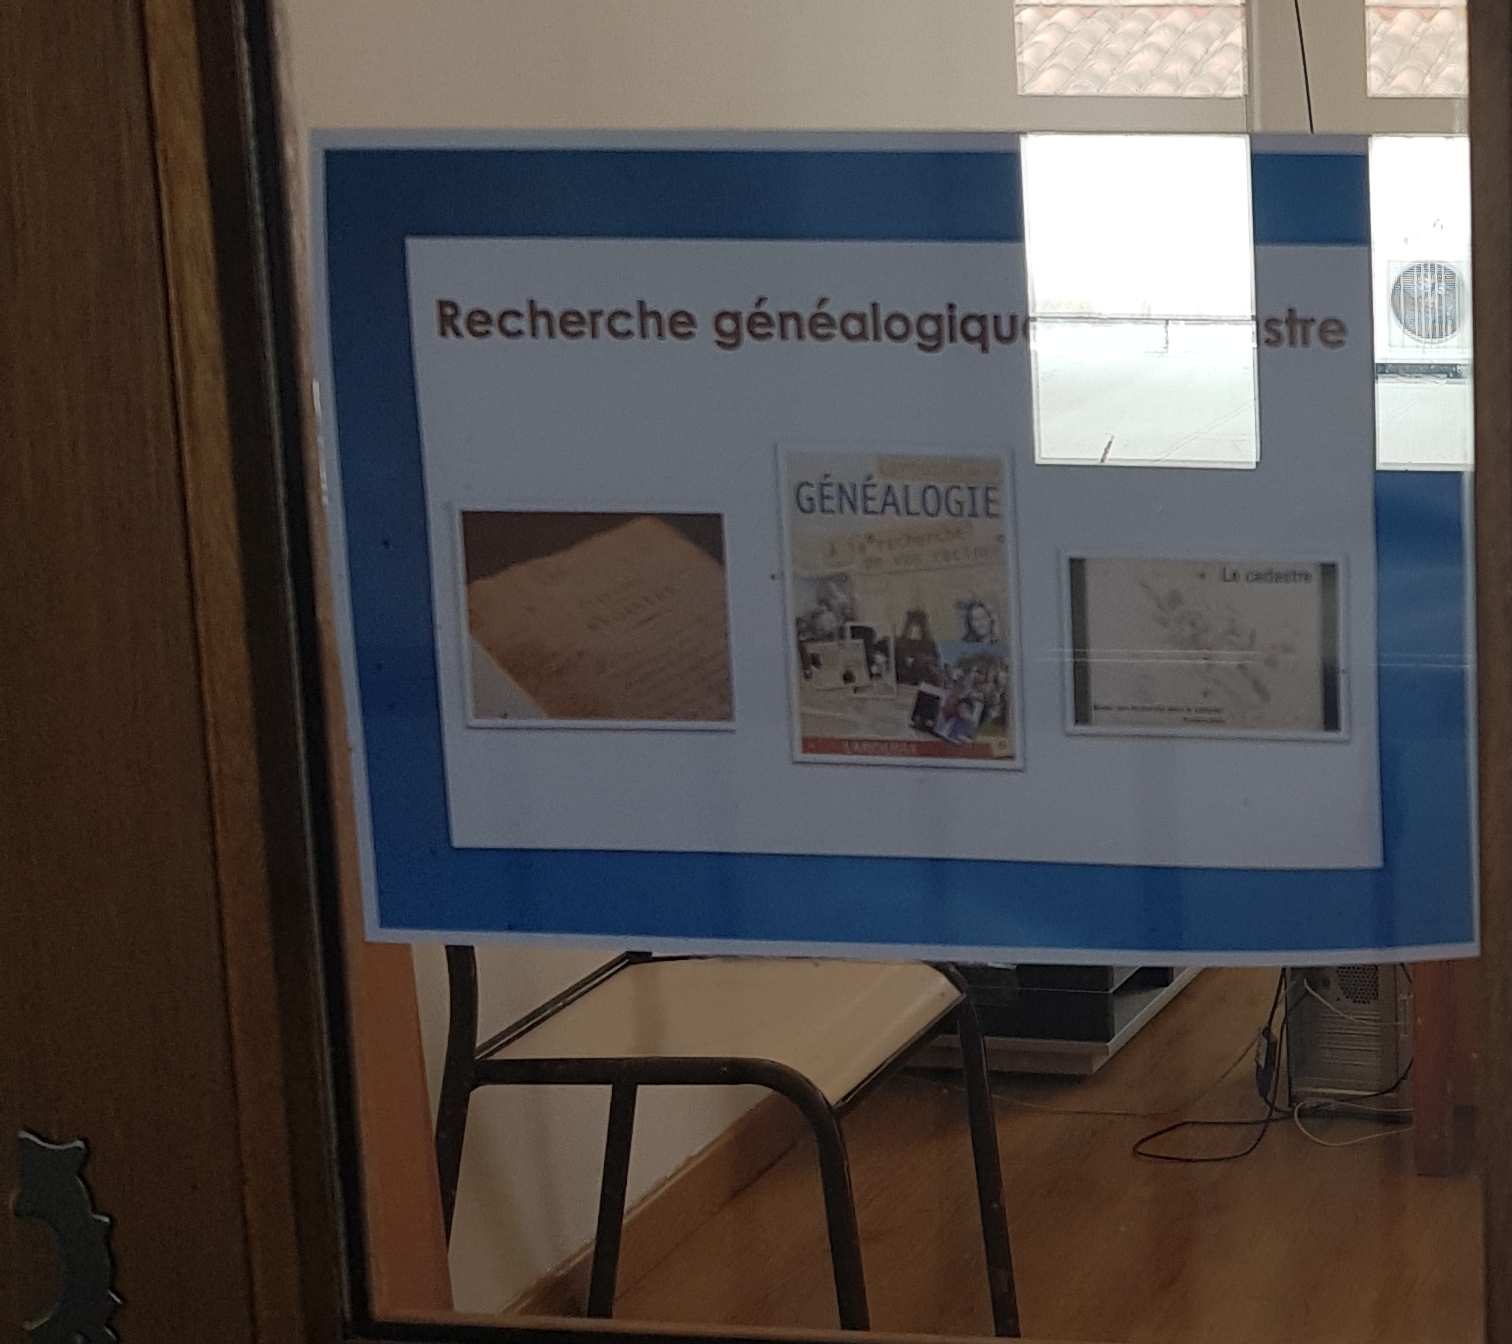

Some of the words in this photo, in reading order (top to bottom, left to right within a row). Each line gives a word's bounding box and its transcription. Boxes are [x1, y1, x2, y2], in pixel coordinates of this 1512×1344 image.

[436, 297, 698, 340] Recherche
[713, 296, 1029, 354] généalogiqu
[795, 473, 1001, 520] GÉNÉALOGIE
[1222, 565, 1240, 584] Le
[1245, 566, 1314, 585] cadastre
